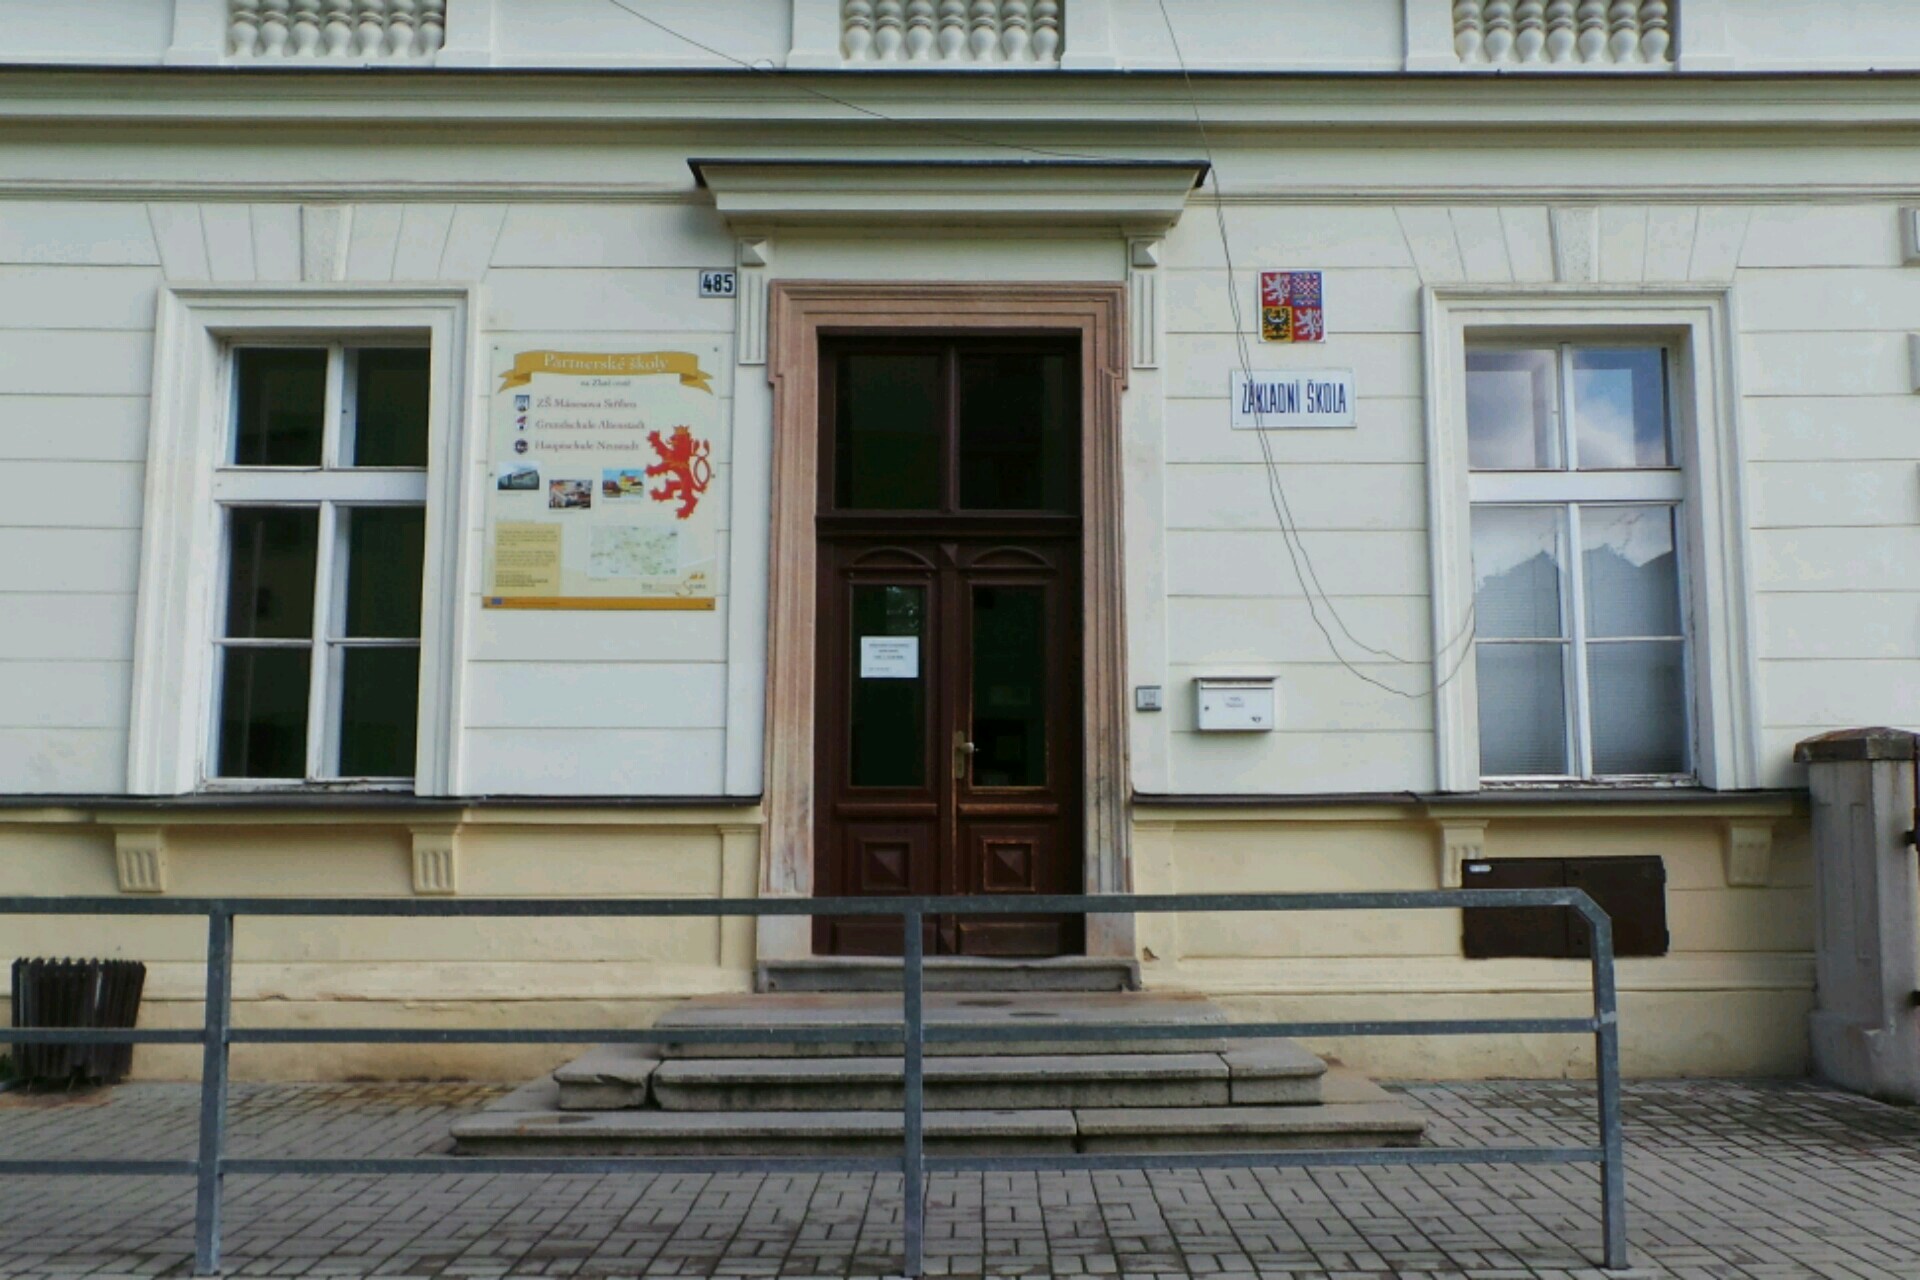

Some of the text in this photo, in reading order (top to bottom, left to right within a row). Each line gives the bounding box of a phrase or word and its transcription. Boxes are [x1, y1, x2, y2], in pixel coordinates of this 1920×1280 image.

[703, 274, 733, 293] 485
[544, 352, 668, 372] Partnerské školy
[537, 396, 551, 408] ZŠ
[1241, 379, 1347, 414] ZÁKLADNÍ ŠKOLA
